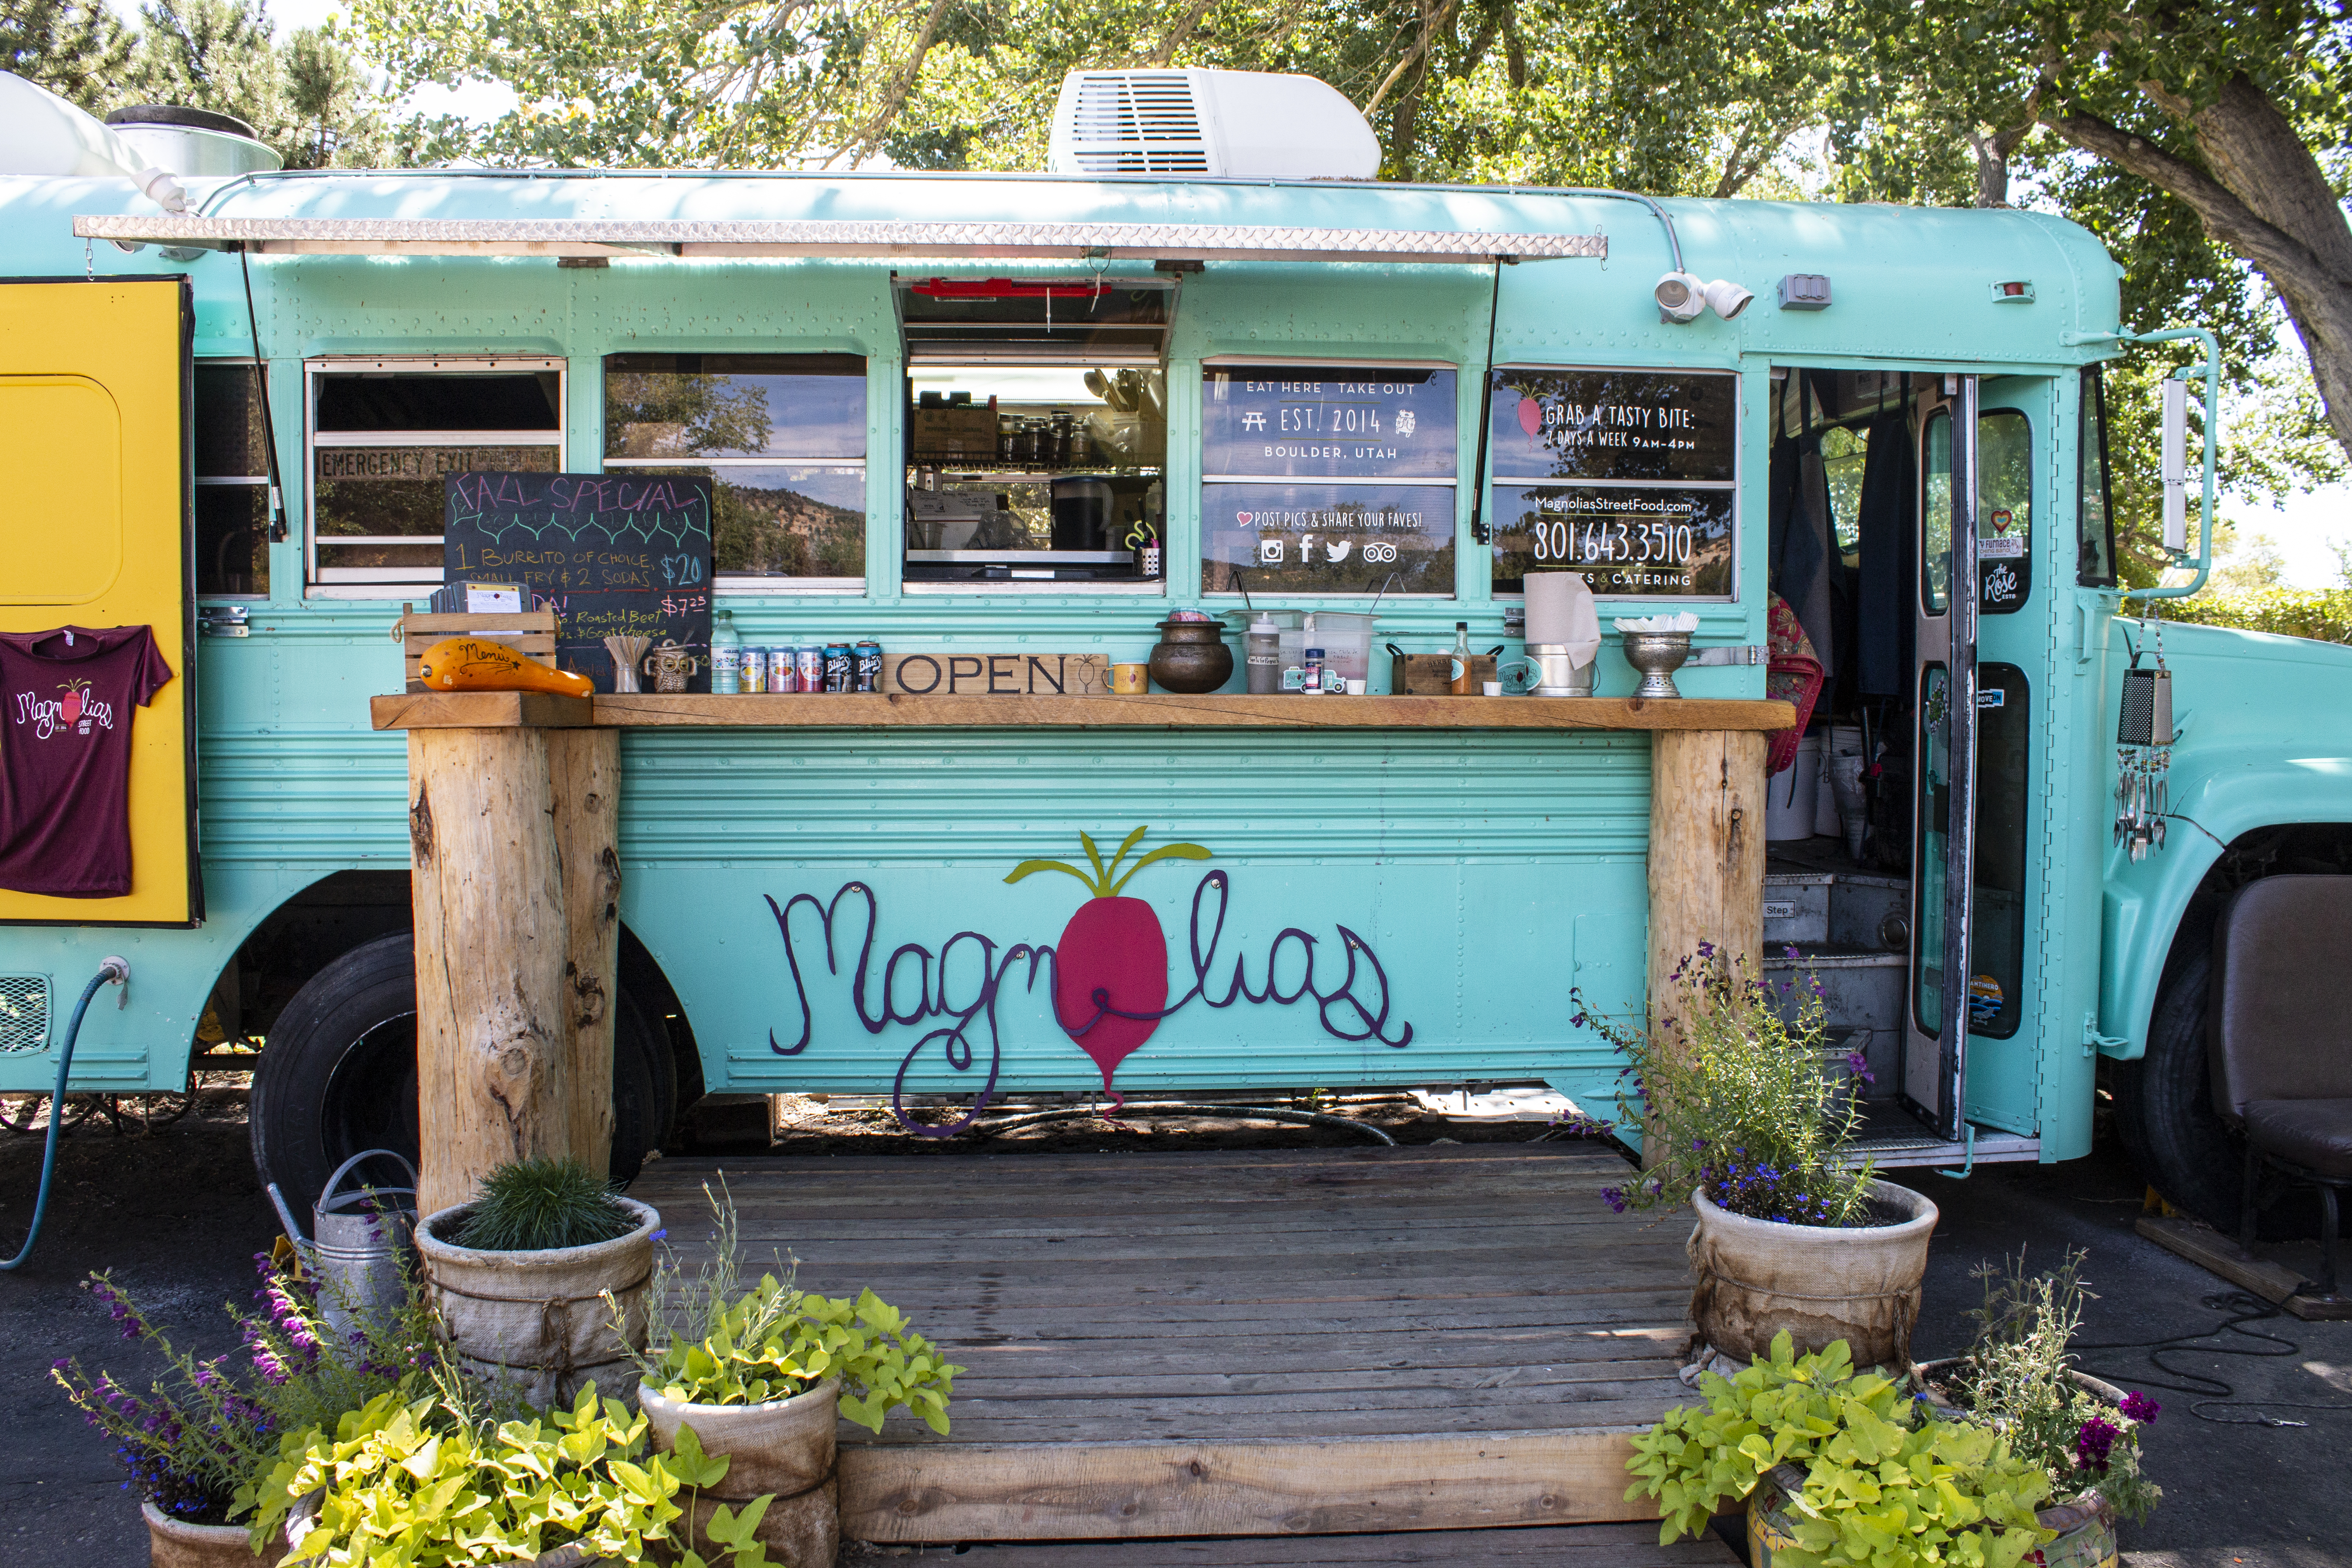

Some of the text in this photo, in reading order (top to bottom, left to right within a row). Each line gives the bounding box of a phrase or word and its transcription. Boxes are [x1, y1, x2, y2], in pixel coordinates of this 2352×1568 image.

[1246, 382, 1415, 395] EAT HERE TAKE OUT
[1281, 409, 1380, 433] EST. 2014
[1546, 404, 1695, 429] GRAB A TASTY BITE:
[1547, 430, 1553, 445] 7
[1558, 430, 1582, 446] DAYS
[1587, 431, 1593, 446] A
[1599, 432, 1628, 447] WEEK
[1265, 447, 1397, 459] BOULDER, UTAH
[323, 452, 472, 476] EMERGENCY EXIT
[456, 473, 698, 513] FALL SPECIAL
[1535, 496, 1691, 513] MagnoliasStreetFood.com
[1255, 512, 1422, 527] POST PICS & SHARE YOUR FAVES!
[1534, 522, 1691, 562] 801.643.3510
[524, 570, 552, 585] FRY
[577, 568, 591, 585] 2
[602, 570, 650, 586] SODAS
[573, 551, 593, 564] OF
[661, 553, 702, 586] $20
[1993, 563, 2008, 578] The
[1600, 573, 1608, 582] &
[1613, 573, 1691, 586] CATERING
[576, 609, 625, 623] Roasted
[459, 643, 510, 662] Menu
[896, 654, 1066, 694] OPEN
[78, 720, 92, 728] STREET
[1767, 906, 1788, 916] Step
[1970, 980, 1999, 990] ANTIHERO
